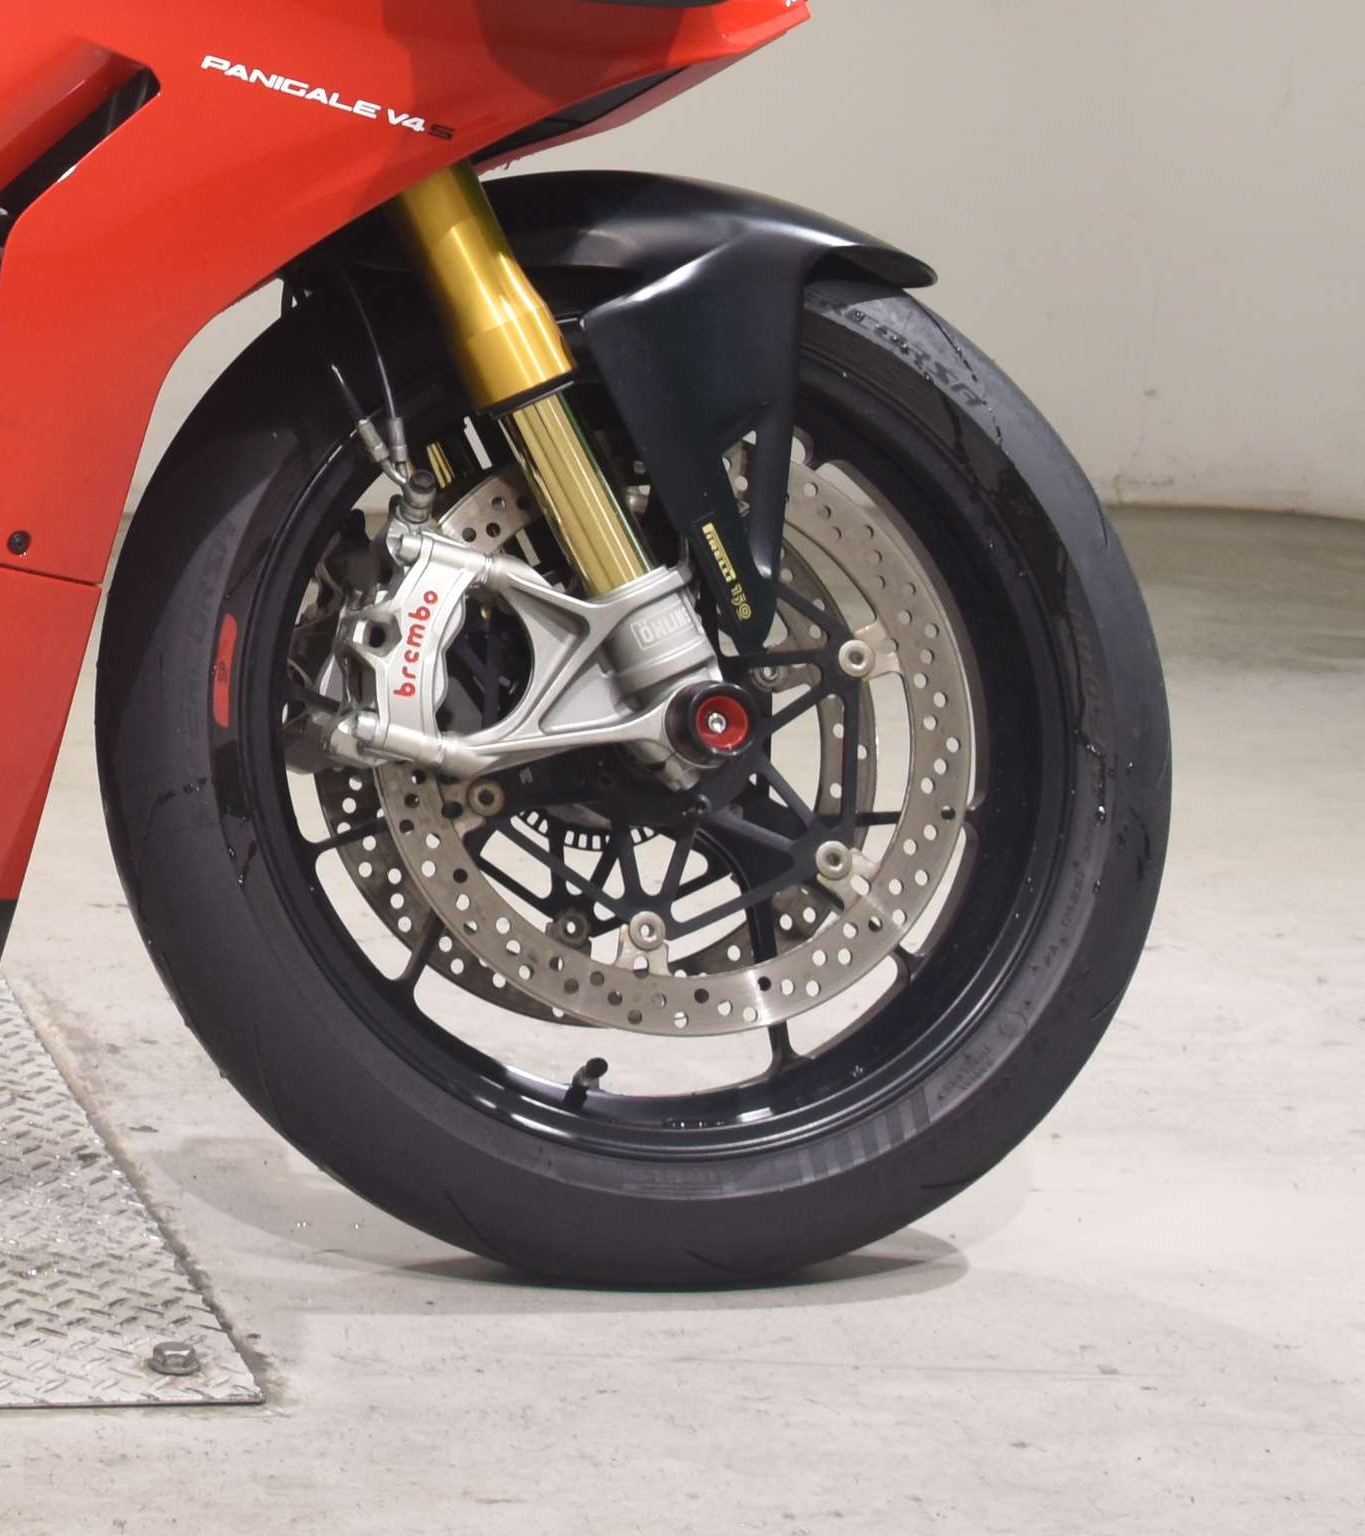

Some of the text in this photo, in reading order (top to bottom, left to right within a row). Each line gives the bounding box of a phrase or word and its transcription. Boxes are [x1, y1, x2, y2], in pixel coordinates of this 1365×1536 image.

[200, 55, 382, 119] PANIGALE
[387, 109, 426, 132] V4
[805, 289, 989, 406] ERCORSA
[702, 522, 737, 582] PIRELLI
[393, 590, 439, 697] brembo
